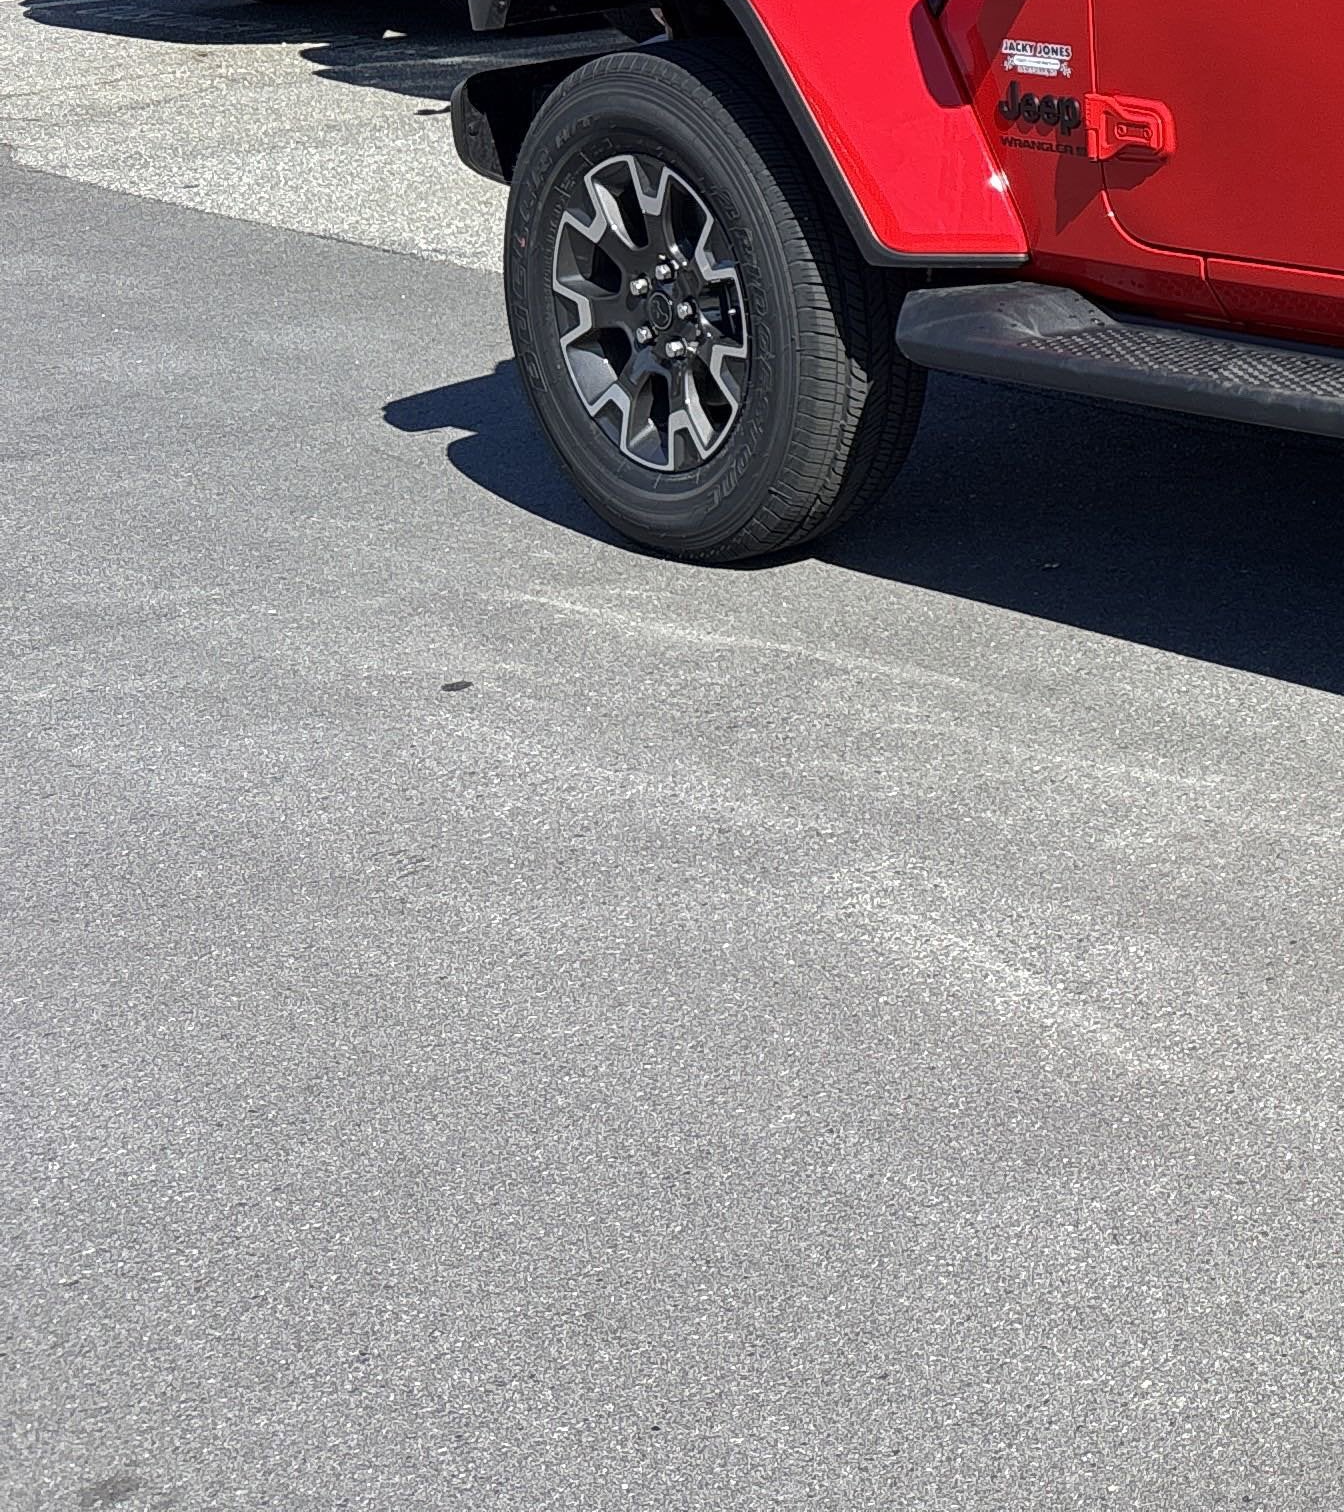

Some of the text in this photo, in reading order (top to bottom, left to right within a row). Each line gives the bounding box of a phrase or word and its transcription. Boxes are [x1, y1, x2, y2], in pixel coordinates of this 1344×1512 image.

[1003, 39, 1072, 59] JACKY JONES
[998, 80, 1082, 136] Jeep
[1001, 135, 1074, 155] WRANGLER
